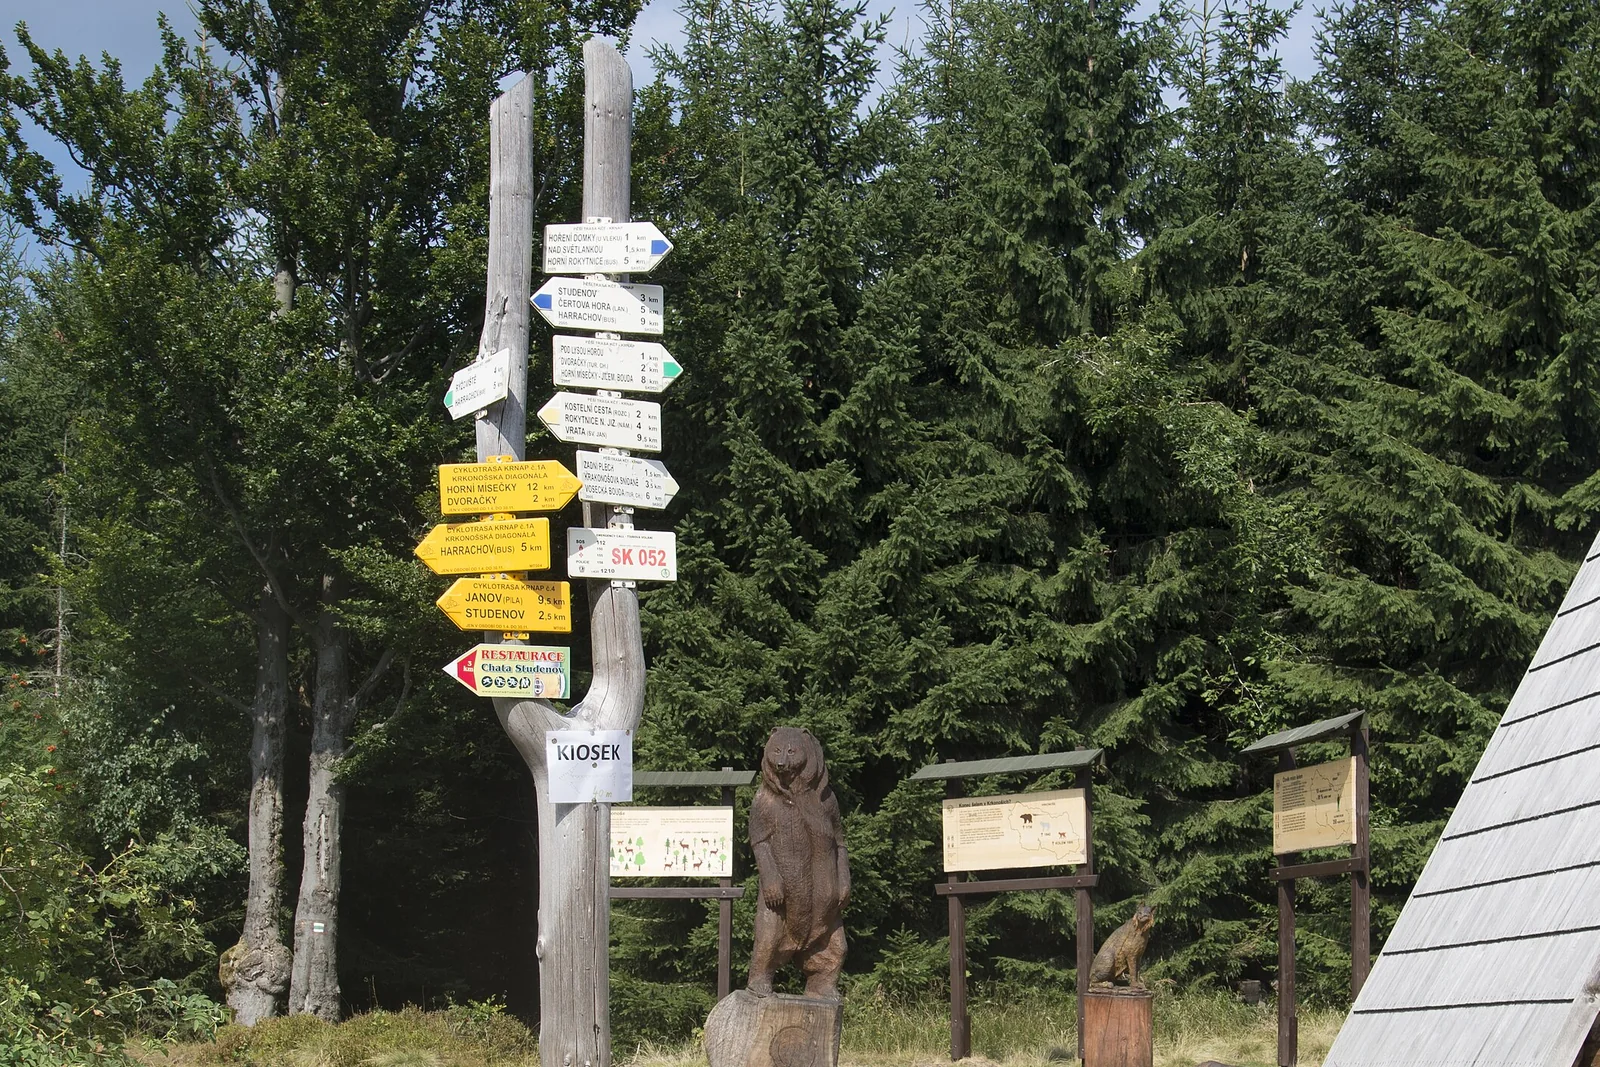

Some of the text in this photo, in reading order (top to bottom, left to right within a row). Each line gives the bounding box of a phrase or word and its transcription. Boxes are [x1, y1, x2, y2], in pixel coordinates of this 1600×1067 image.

[549, 233, 572, 242] HOŘENÍ
[574, 233, 596, 242] DOMKY
[563, 244, 603, 253] SVĚTLANKOU
[548, 256, 567, 265] HORNÍ
[568, 257, 603, 265] ROKYTNICE
[558, 287, 597, 298] STUDENOV
[640, 294, 645, 302] 3
[558, 298, 590, 309] ČERTOVA
[592, 302, 611, 311] HORA
[558, 311, 601, 322] HARRACHOV
[602, 316, 616, 324] (BUS)
[640, 317, 645, 326] 9
[561, 345, 570, 354] POD
[587, 347, 604, 356] HOROU
[561, 356, 586, 366] DVORAČKY
[561, 368, 575, 378] HORNÍ
[577, 368, 597, 380] MÍSEČKY
[617, 374, 633, 383] BOUDA
[565, 402, 593, 413] KOSTELNÍ
[594, 405, 612, 415] CESTA
[565, 414, 599, 425] ROKYTNICE
[600, 418, 606, 426] N.
[566, 426, 586, 435] VRATA
[637, 434, 647, 442] 9,5
[584, 460, 598, 470] ZADNÍ
[599, 463, 614, 472] PLECH
[447, 484, 475, 494] HORNÍ
[477, 482, 517, 492] MÍSEČKY
[527, 483, 538, 491] 12
[608, 487, 625, 495] BOUDA
[448, 495, 497, 506] DVORAČKY
[533, 495, 538, 503] 2
[440, 544, 494, 556] HARRACHOV
[494, 546, 515, 555] (BUS)
[521, 542, 527, 552] 5
[612, 548, 666, 566] SK 052
[465, 593, 502, 602] JANOV
[538, 595, 551, 605] 9,5
[466, 608, 525, 619] STUDENOV
[539, 611, 552, 621] 2,5
[481, 650, 564, 662] RESTAURACE
[481, 664, 564, 674] Chata Studenov
[557, 744, 620, 760] KIOSEK
